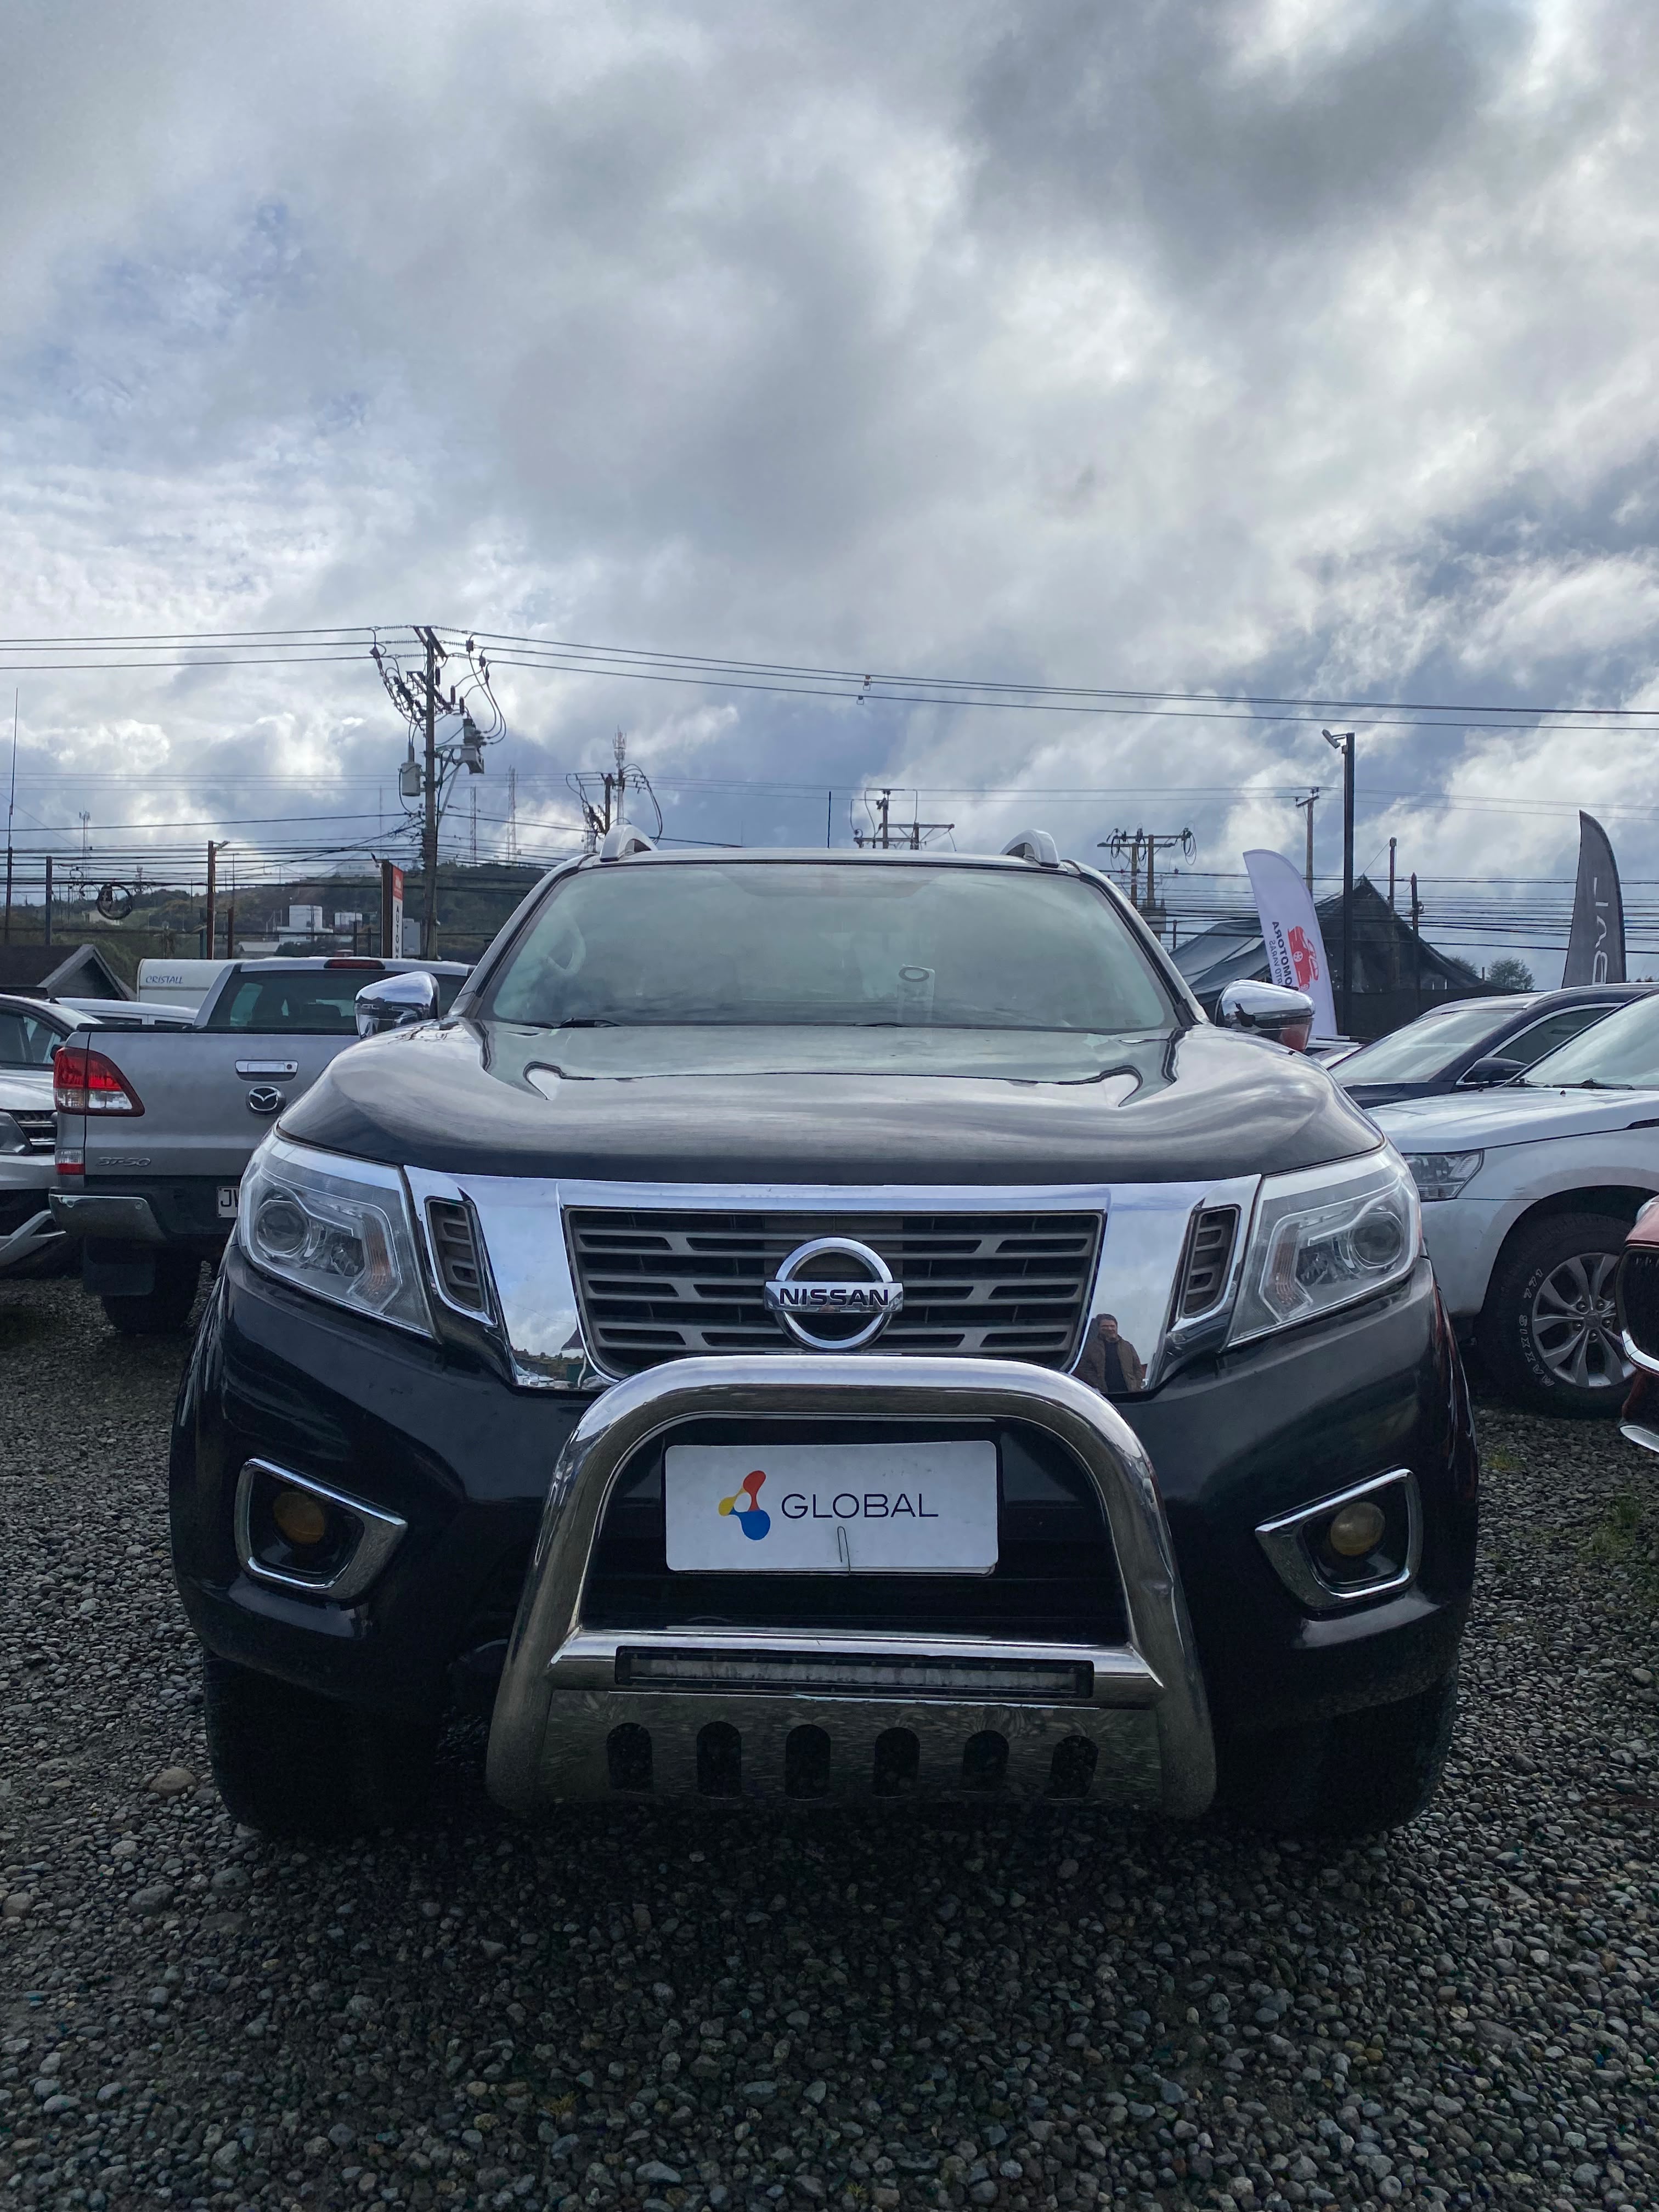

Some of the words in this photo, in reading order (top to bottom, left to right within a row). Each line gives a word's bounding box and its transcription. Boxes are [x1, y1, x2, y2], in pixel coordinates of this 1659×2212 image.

[145, 975, 183, 984] CRISTALL
[780, 1288, 889, 1306] NISSAN
[1519, 1314, 1555, 1386] MAXXIS
[781, 1493, 939, 1519] GLOBAL
